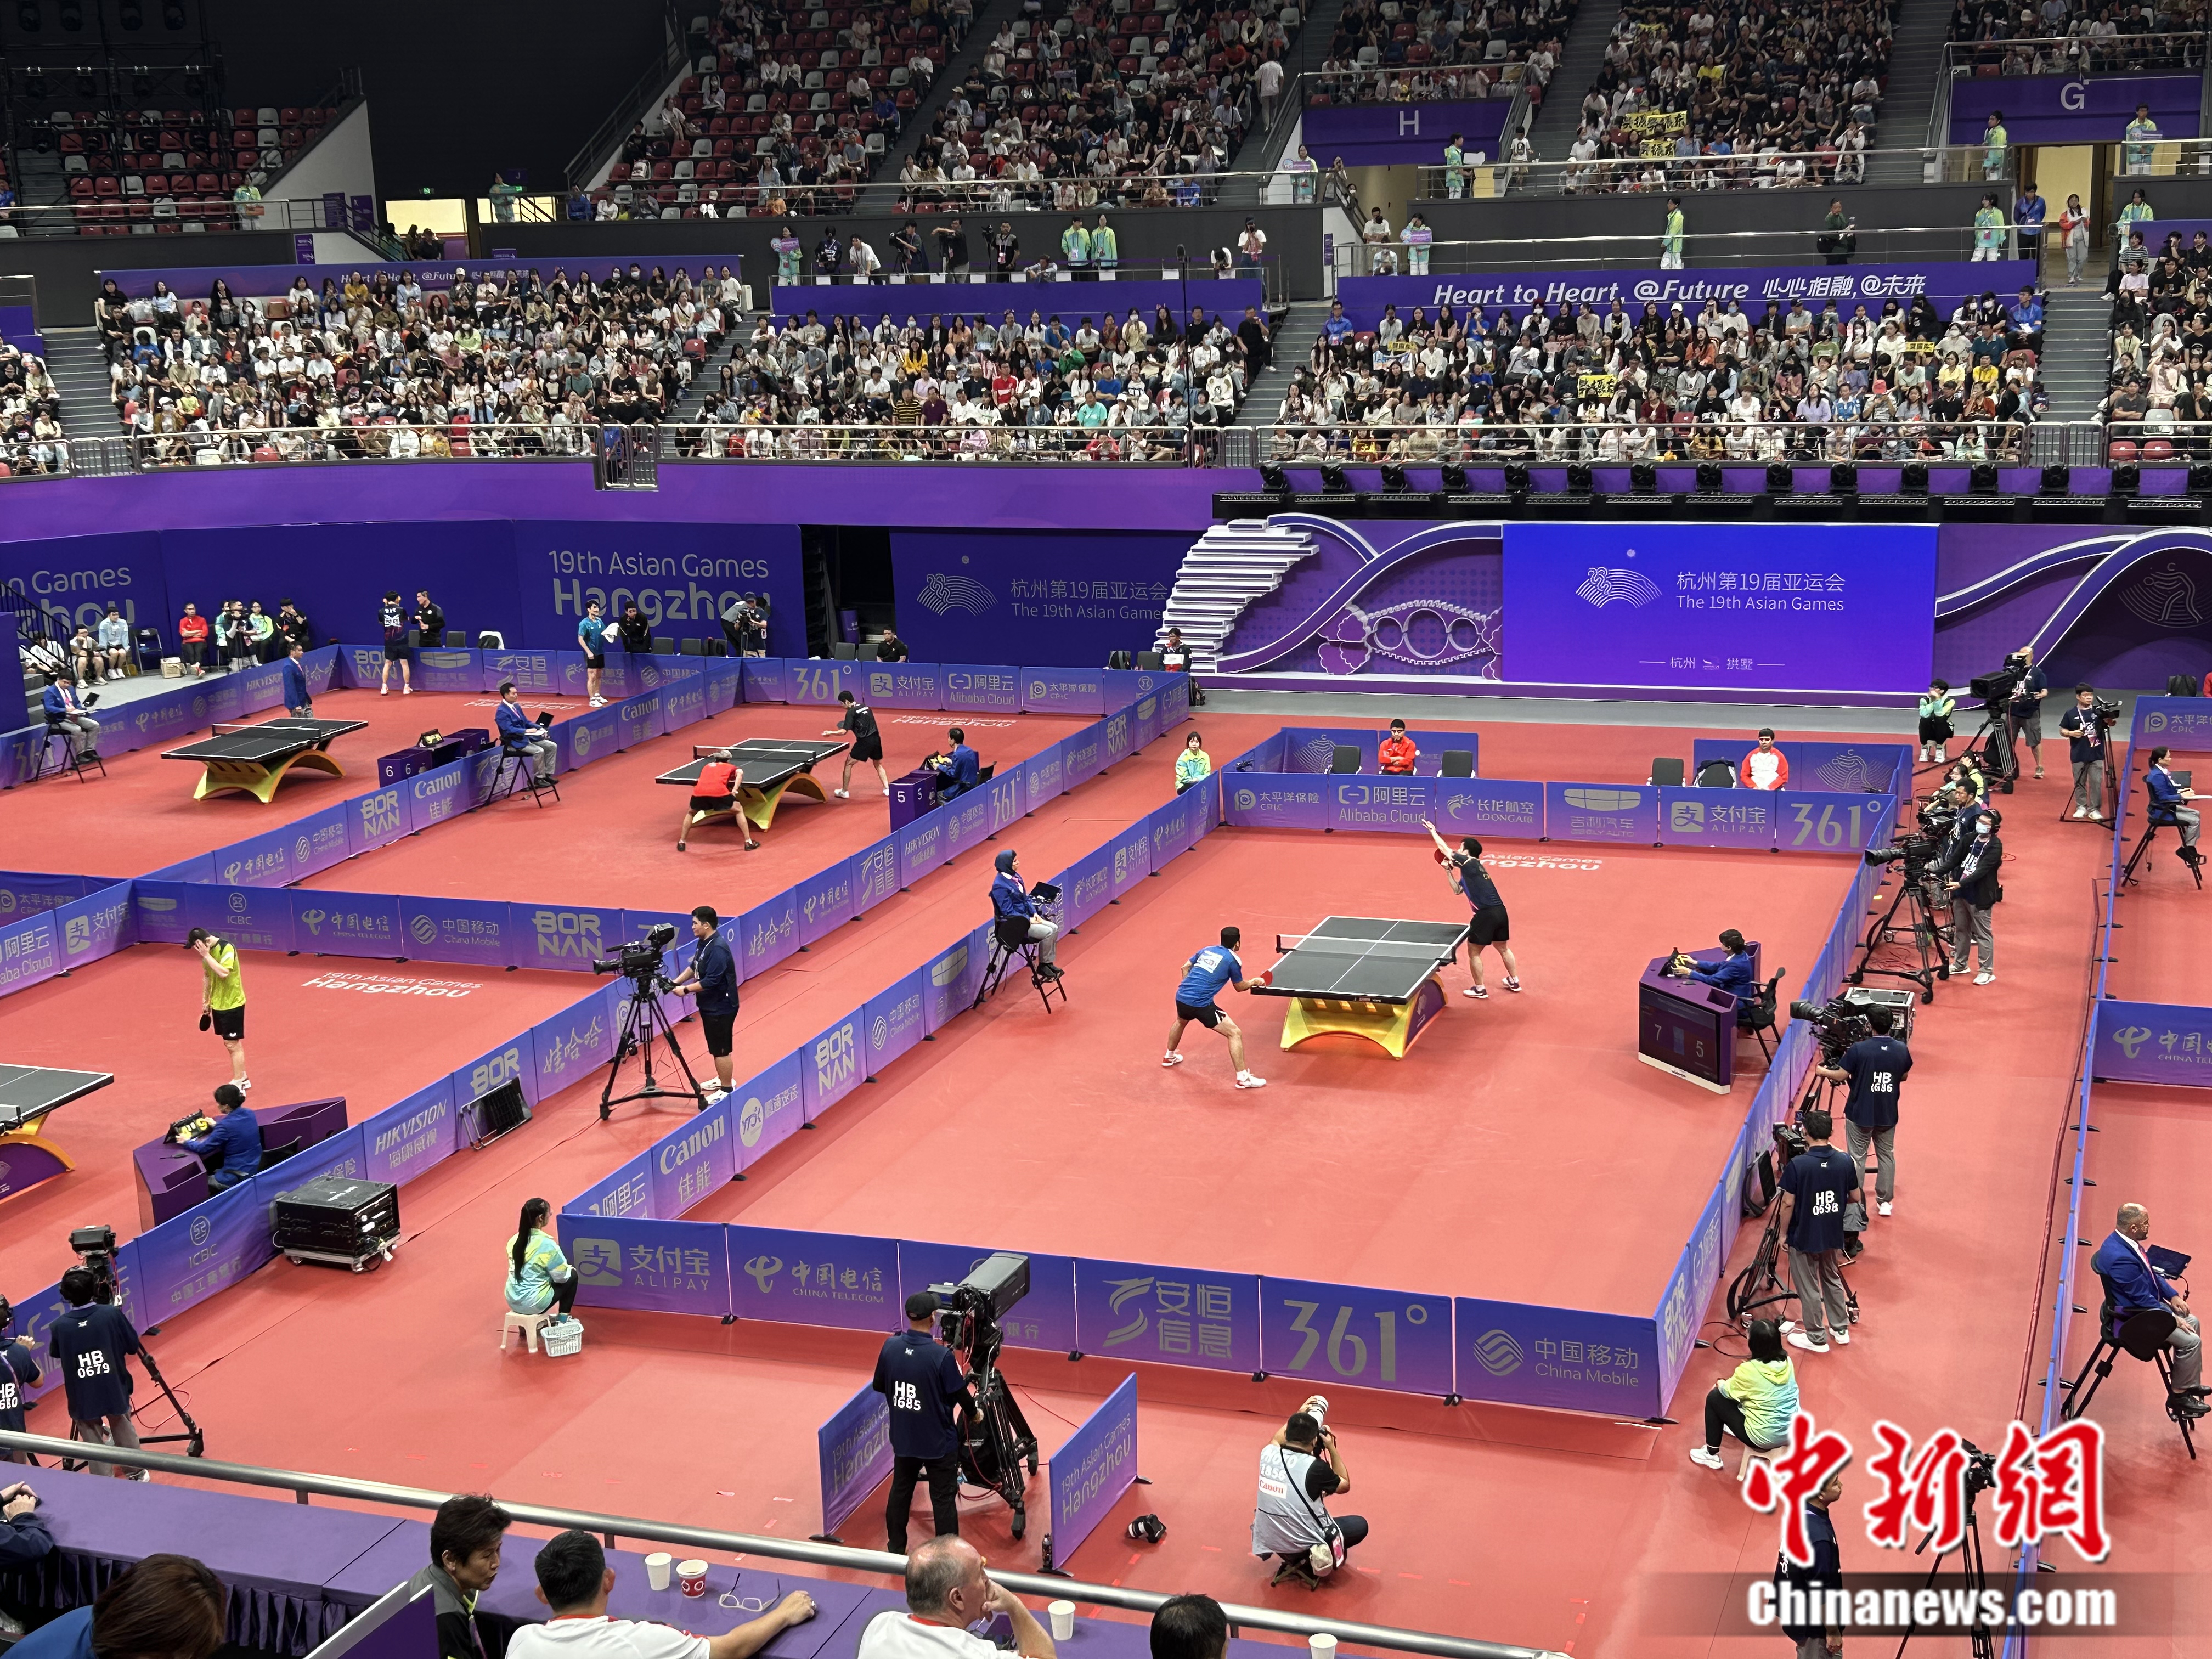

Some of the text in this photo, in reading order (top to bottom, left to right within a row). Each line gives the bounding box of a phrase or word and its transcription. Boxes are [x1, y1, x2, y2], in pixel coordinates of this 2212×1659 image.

[2061, 83, 2085, 110] G
[1399, 110, 1419, 136] H
[341, 271, 456, 284] Hert @Futu
[1435, 279, 1749, 305] Heart to Heart, @Future
[549, 550, 769, 579] 19th Asian Games
[32, 567, 132, 594] Games
[1011, 578, 1169, 601] 杭州第19届亚运会
[1676, 571, 1846, 593] 杭州第19届亚运会
[1011, 602, 1165, 620] The 19th Asian Game
[1676, 595, 1844, 612] The 19th Asian Games
[793, 665, 852, 701] 361°
[897, 676, 934, 691] 支付宝
[974, 674, 1014, 691] 阿里云
[622, 697, 659, 722] Canon
[949, 692, 1015, 706] Alibaba Cloud
[2171, 714, 2212, 725] 太平洋
[415, 770, 461, 800] Canon
[897, 791, 906, 803] 5
[1260, 791, 1320, 804] 太平洋保险
[1373, 786, 1426, 806] 阿里云
[360, 790, 399, 820] BOR
[992, 770, 1022, 830] 361°
[363, 808, 400, 839] NAN
[1339, 808, 1426, 823] Alibaba Cloud
[1477, 812, 1534, 825] LOONGAIR
[1710, 805, 1767, 826] 支付宝
[1791, 800, 1882, 849] 361°
[1711, 823, 1765, 834] ALIPAY
[1480, 859, 1600, 871] ngzhou
[227, 915, 253, 926] ICBC
[331, 912, 390, 933] 中国电信
[442, 918, 499, 936] 中国移动
[531, 911, 601, 936] BOR
[4, 926, 50, 962] 阿里云
[537, 934, 604, 959] NAN
[22, 951, 53, 977] Cloud
[301, 977, 472, 998] Hangzhou
[366, 974, 418, 985] Asian
[421, 978, 484, 990] Games
[544, 1015, 603, 1074] 娃哈哈
[1654, 1023, 1662, 1041] 7
[815, 1023, 853, 1069] BOR
[1696, 1040, 1704, 1058] 5
[2158, 1054, 2192, 1063] CHINA
[470, 1047, 520, 1096] BOR
[818, 1047, 855, 1097] NAN
[1873, 1072, 1892, 1084] HB
[375, 1099, 448, 1155] HIKVISION
[660, 1115, 725, 1175] Canon
[603, 1172, 646, 1217] 阿里云
[678, 1160, 712, 1205] 佳能
[1816, 1190, 1835, 1205] HB
[189, 1243, 218, 1269] ICBC
[628, 1244, 710, 1277] 支付宝
[634, 1274, 709, 1291] ALIPAY
[791, 1260, 883, 1293] 中国电信
[793, 1288, 884, 1304] CHINA TELECOM
[1155, 1281, 1232, 1321] 安恒
[1156, 1319, 1233, 1358] 信息
[1284, 1299, 1428, 1383] 361°
[77, 1350, 104, 1368] HB
[1534, 1337, 1639, 1370] 中国移动
[77, 1363, 110, 1379] 0679
[1535, 1362, 1639, 1388] China Mobile
[895, 1380, 916, 1399] HB
[834, 1421, 890, 1494] Hangzh
[1062, 1413, 1131, 1496] 19th Asian Games
[1063, 1434, 1131, 1526] Hangzhou
[1259, 1480, 1284, 1494] Canon
